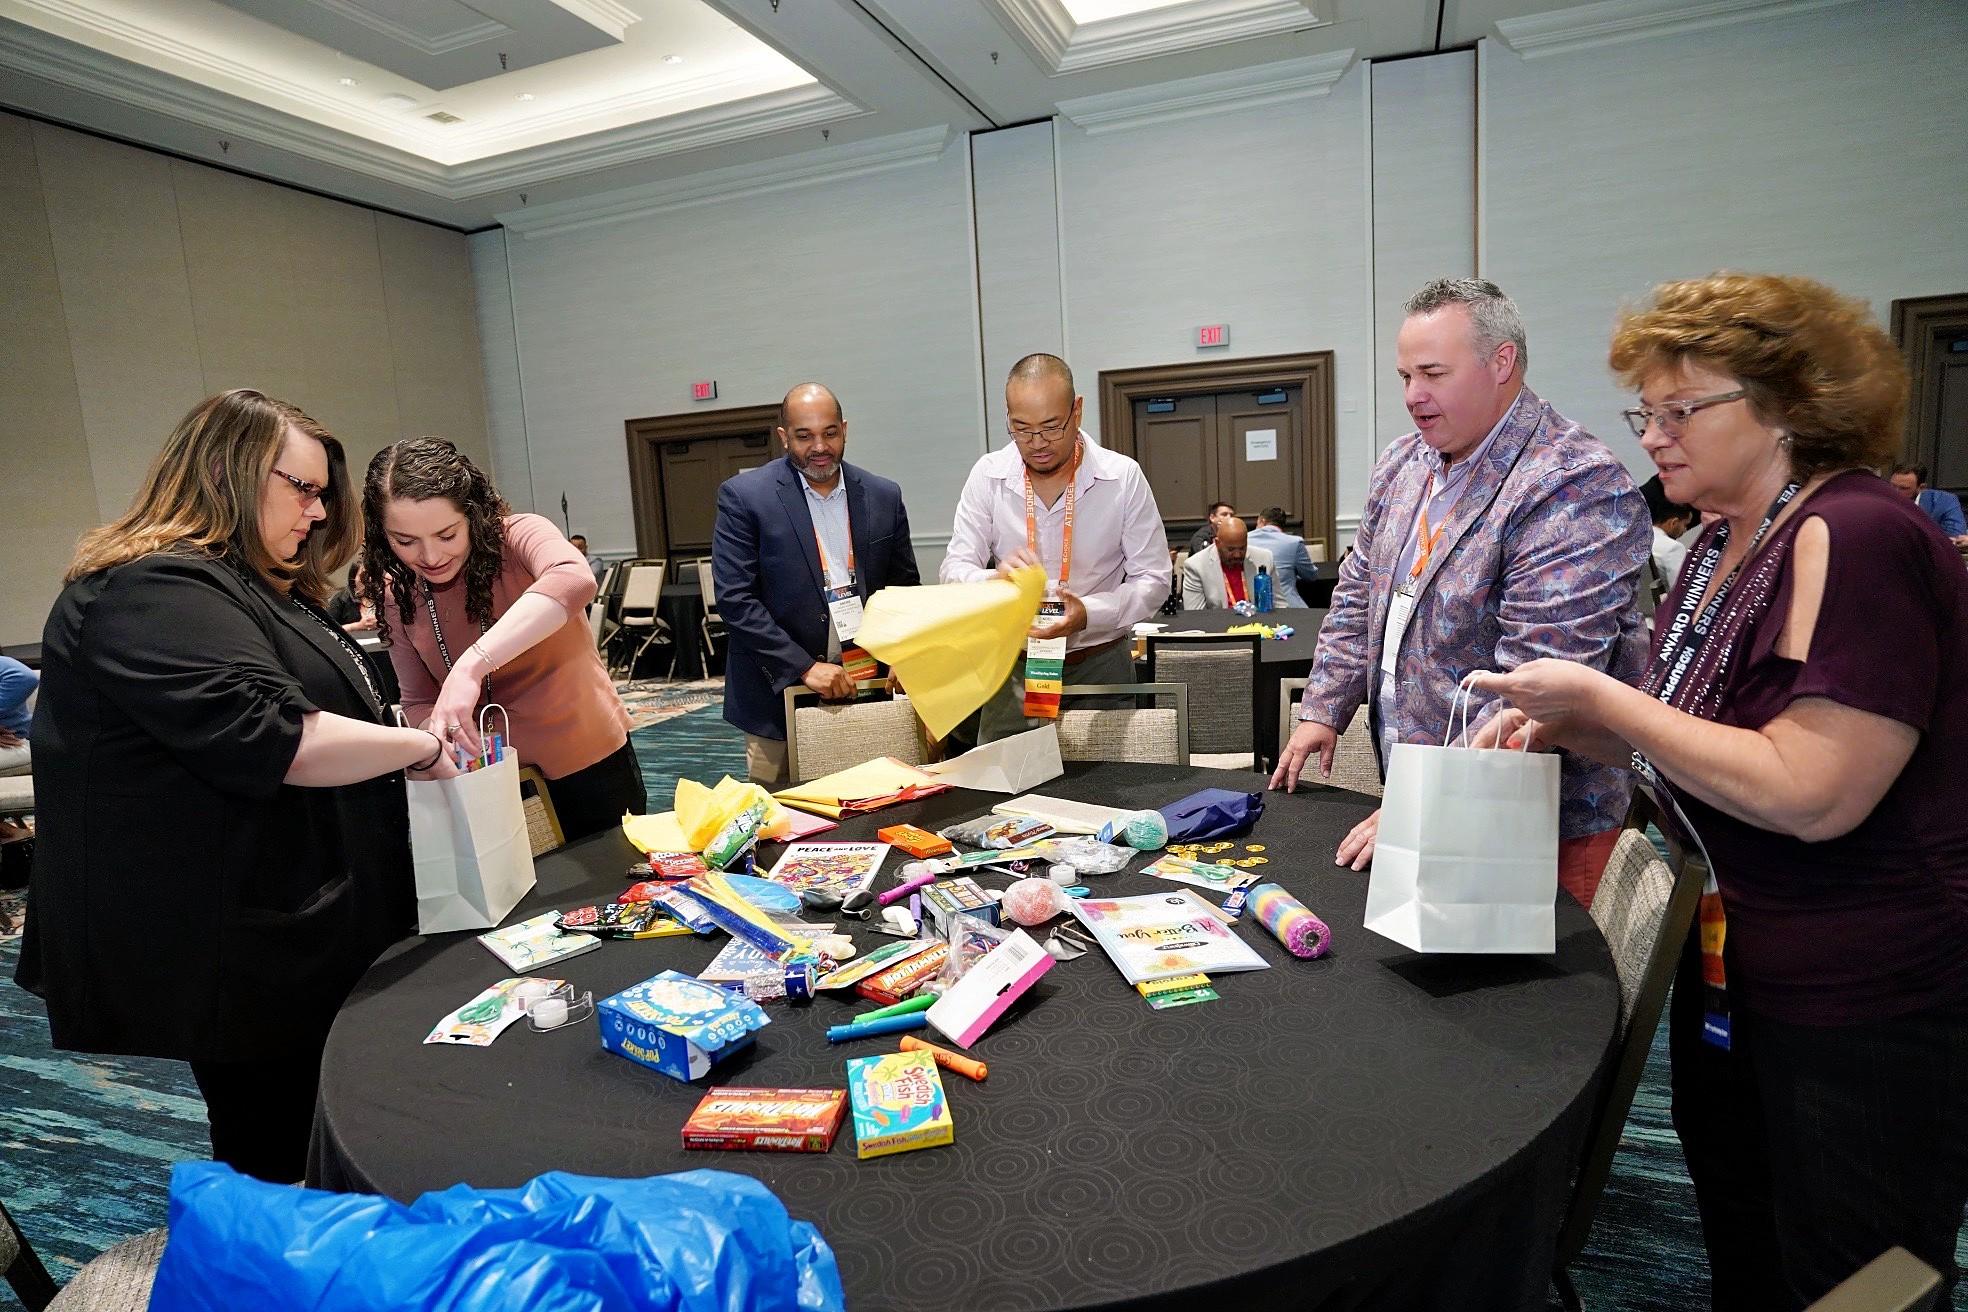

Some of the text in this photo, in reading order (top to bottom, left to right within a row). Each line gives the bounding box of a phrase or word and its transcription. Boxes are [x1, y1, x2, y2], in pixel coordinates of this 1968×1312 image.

[1200, 327, 1222, 344] EXIT
[695, 383, 710, 398] EXIT
[1064, 481, 1074, 527] ATTENDEE
[1659, 548, 1720, 662] AWARD WINNERS
[427, 599, 453, 671] WARD WINNERS
[1152, 922, 1198, 937] Better
[895, 1079, 914, 1099] Fish
[904, 1066, 934, 1105] Swedish
